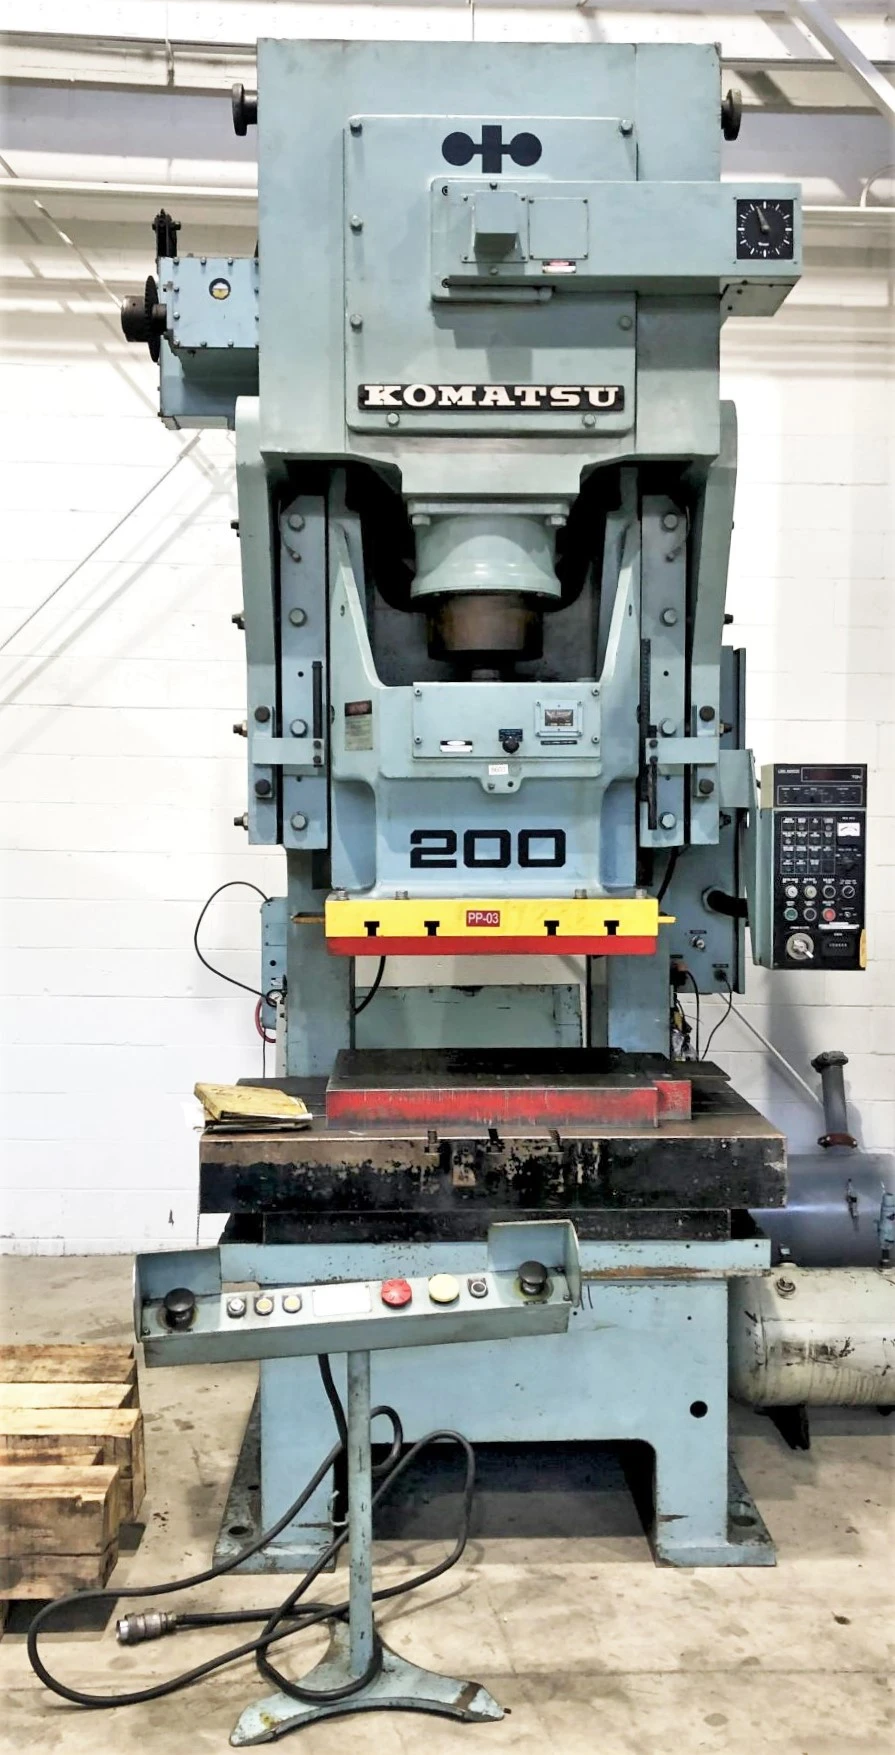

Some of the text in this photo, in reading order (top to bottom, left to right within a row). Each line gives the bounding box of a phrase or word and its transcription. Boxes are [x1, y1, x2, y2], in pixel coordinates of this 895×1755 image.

[364, 384, 620, 407] KOMATSU
[410, 829, 566, 869] 200
[468, 912, 499, 925] PP-03
